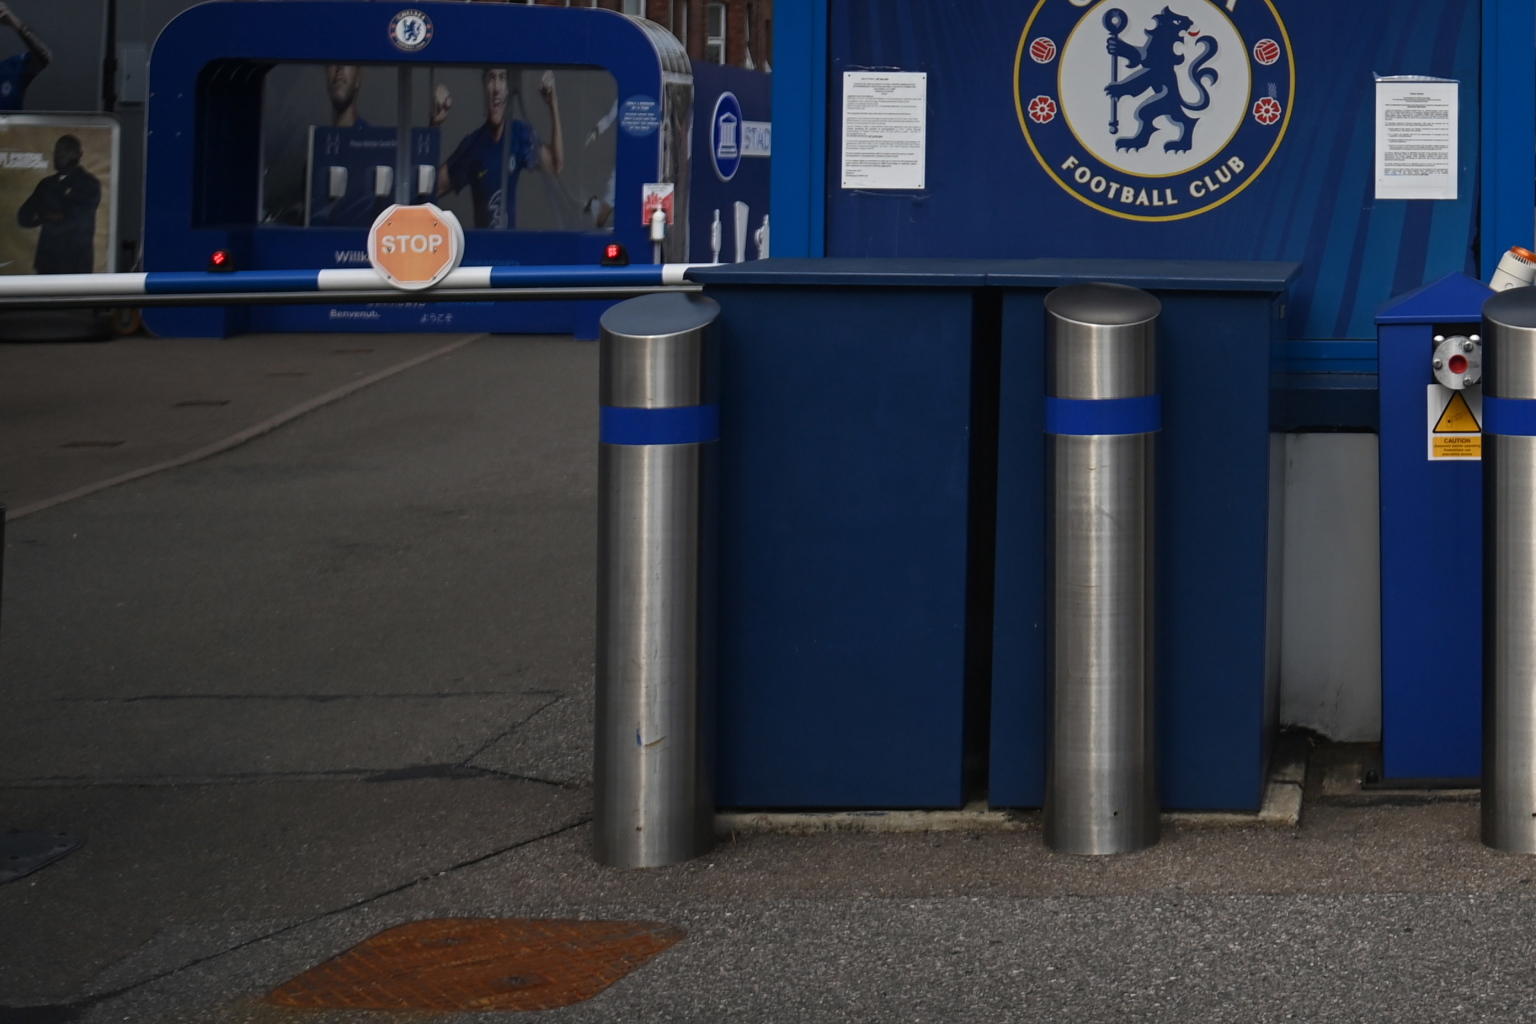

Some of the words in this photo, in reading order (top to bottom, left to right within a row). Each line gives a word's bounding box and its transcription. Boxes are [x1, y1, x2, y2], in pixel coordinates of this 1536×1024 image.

[1061, 155, 1179, 207] FOOTBALL
[1188, 154, 1246, 199] CLUB
[381, 233, 443, 255] STOP
